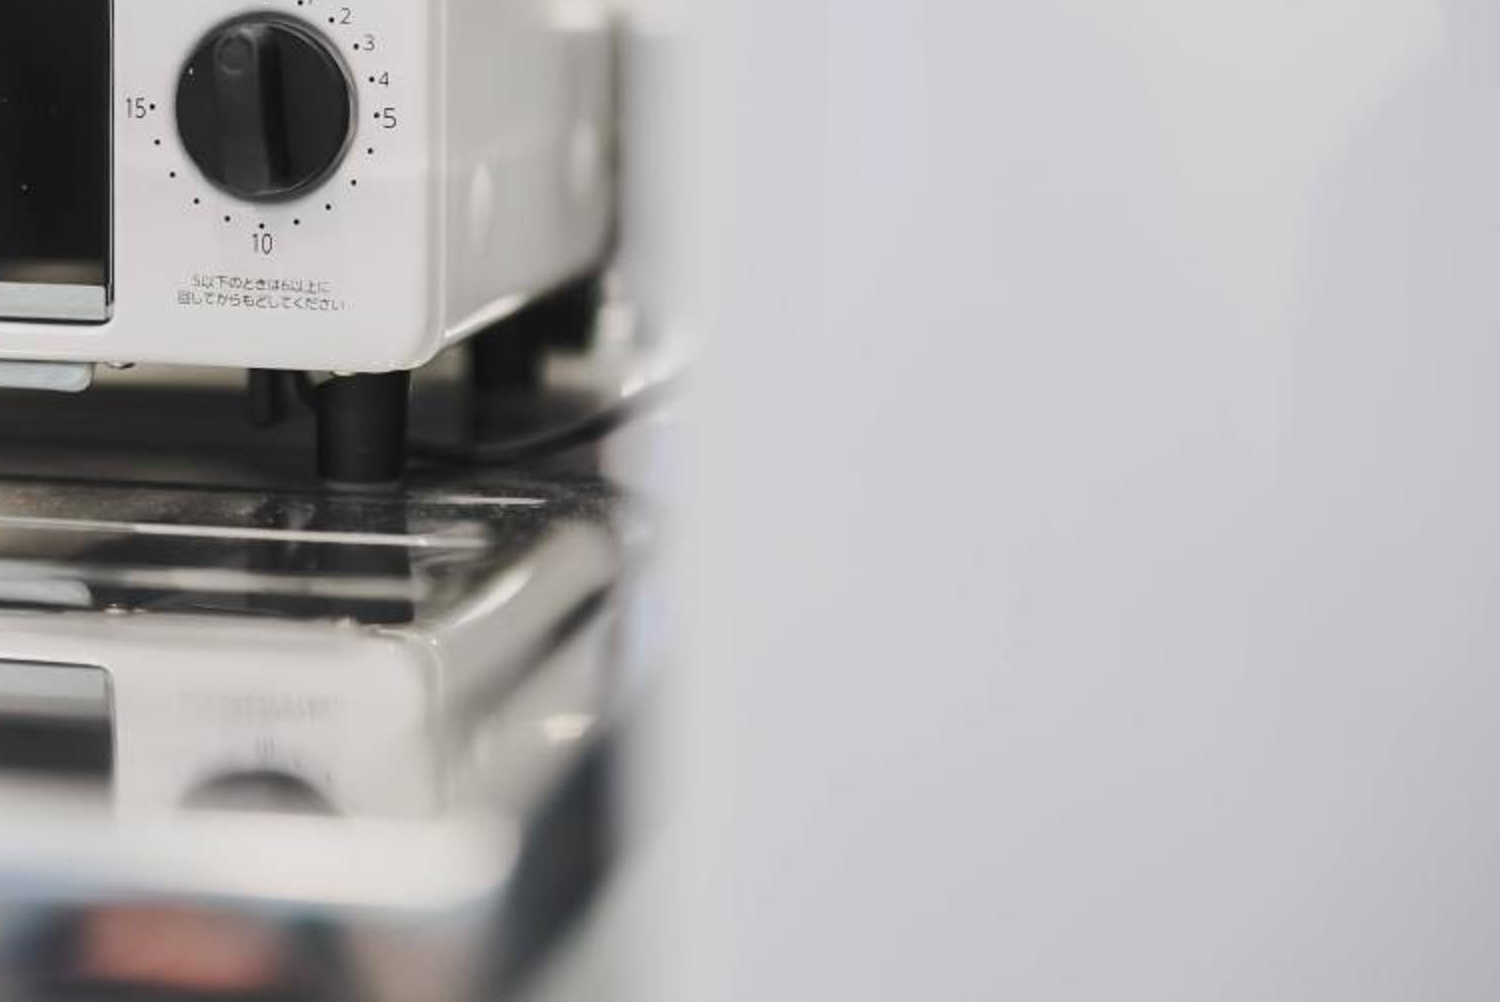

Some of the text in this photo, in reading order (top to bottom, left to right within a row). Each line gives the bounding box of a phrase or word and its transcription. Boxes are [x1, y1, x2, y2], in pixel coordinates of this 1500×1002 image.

[340, 8, 352, 25] 2
[363, 35, 375, 51] 3
[378, 72, 389, 87] 4
[126, 98, 147, 118] 15
[383, 108, 397, 128] 5
[252, 233, 273, 255] 10
